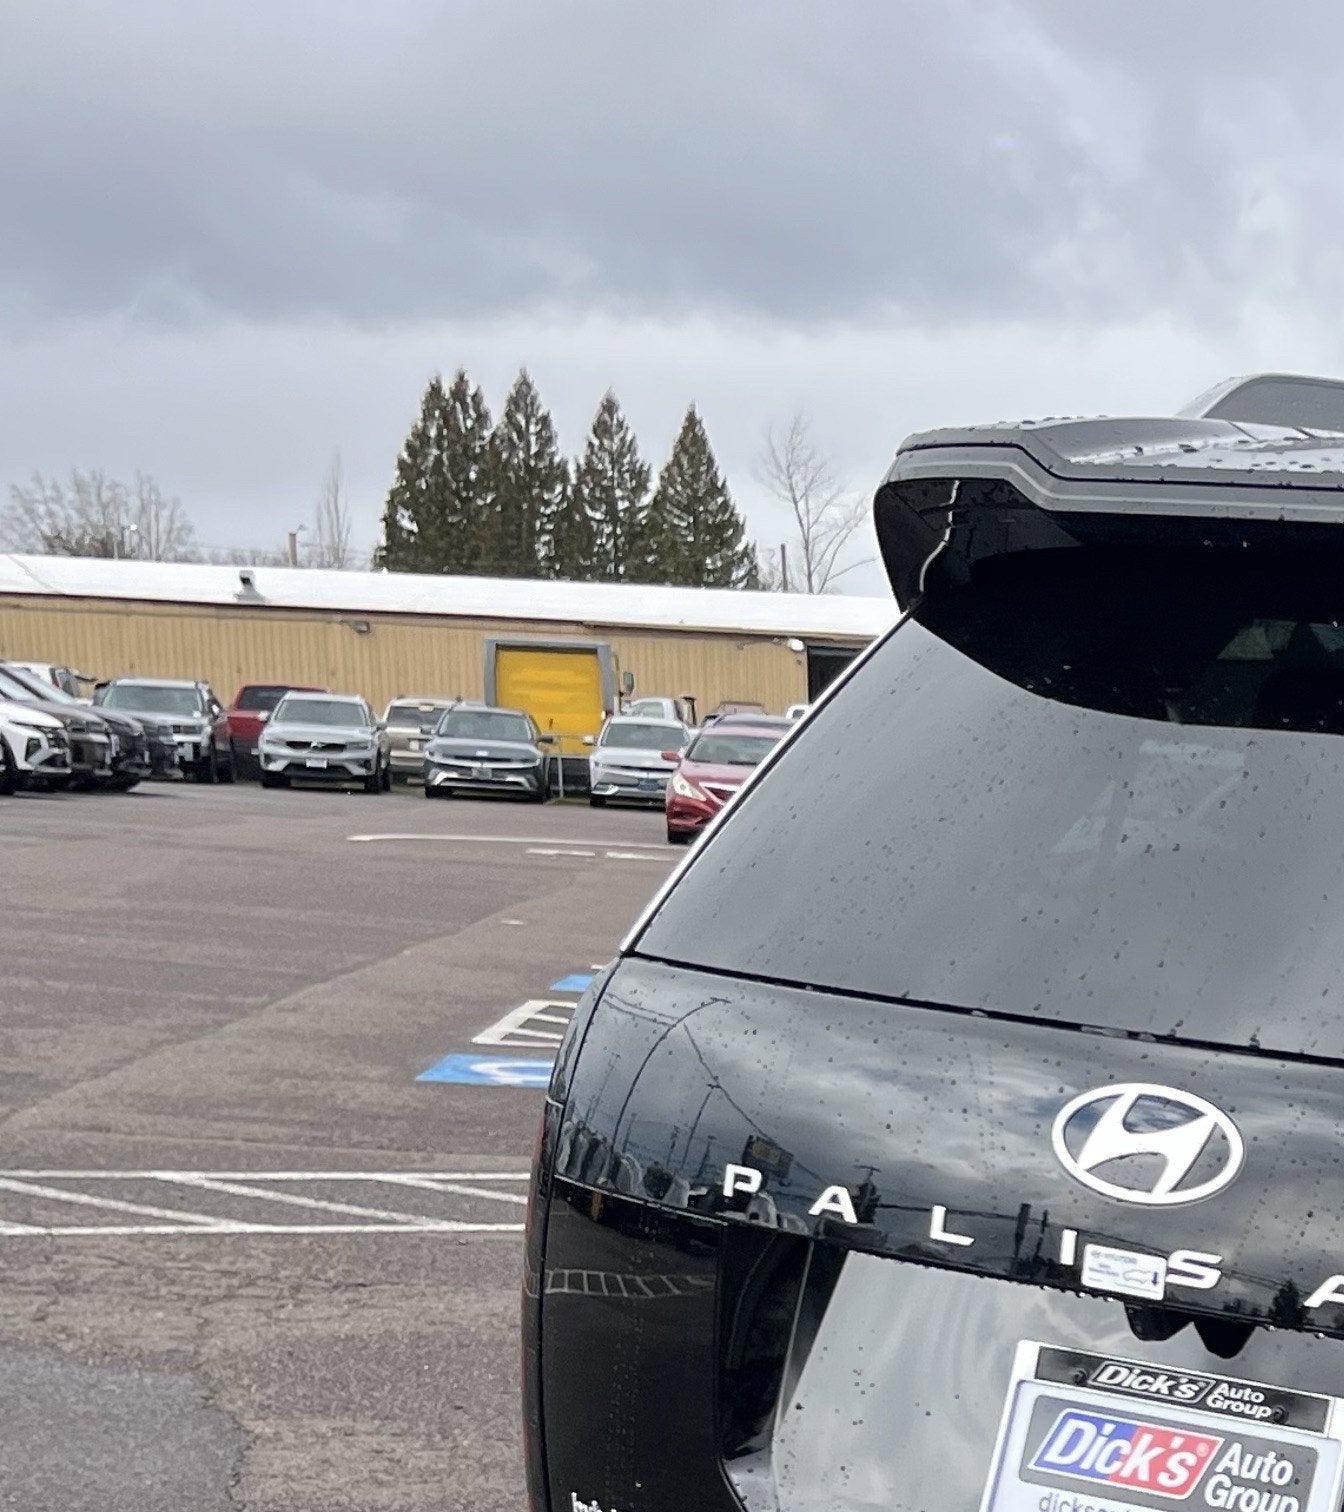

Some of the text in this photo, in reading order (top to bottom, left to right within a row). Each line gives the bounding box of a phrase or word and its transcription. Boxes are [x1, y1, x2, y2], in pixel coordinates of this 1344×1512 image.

[1096, 1364, 1200, 1400] Dick's
[1214, 1382, 1265, 1403] Auto
[1206, 1394, 1272, 1419] Group
[1043, 1418, 1198, 1488] Dick's
[1215, 1442, 1294, 1486] Auto
